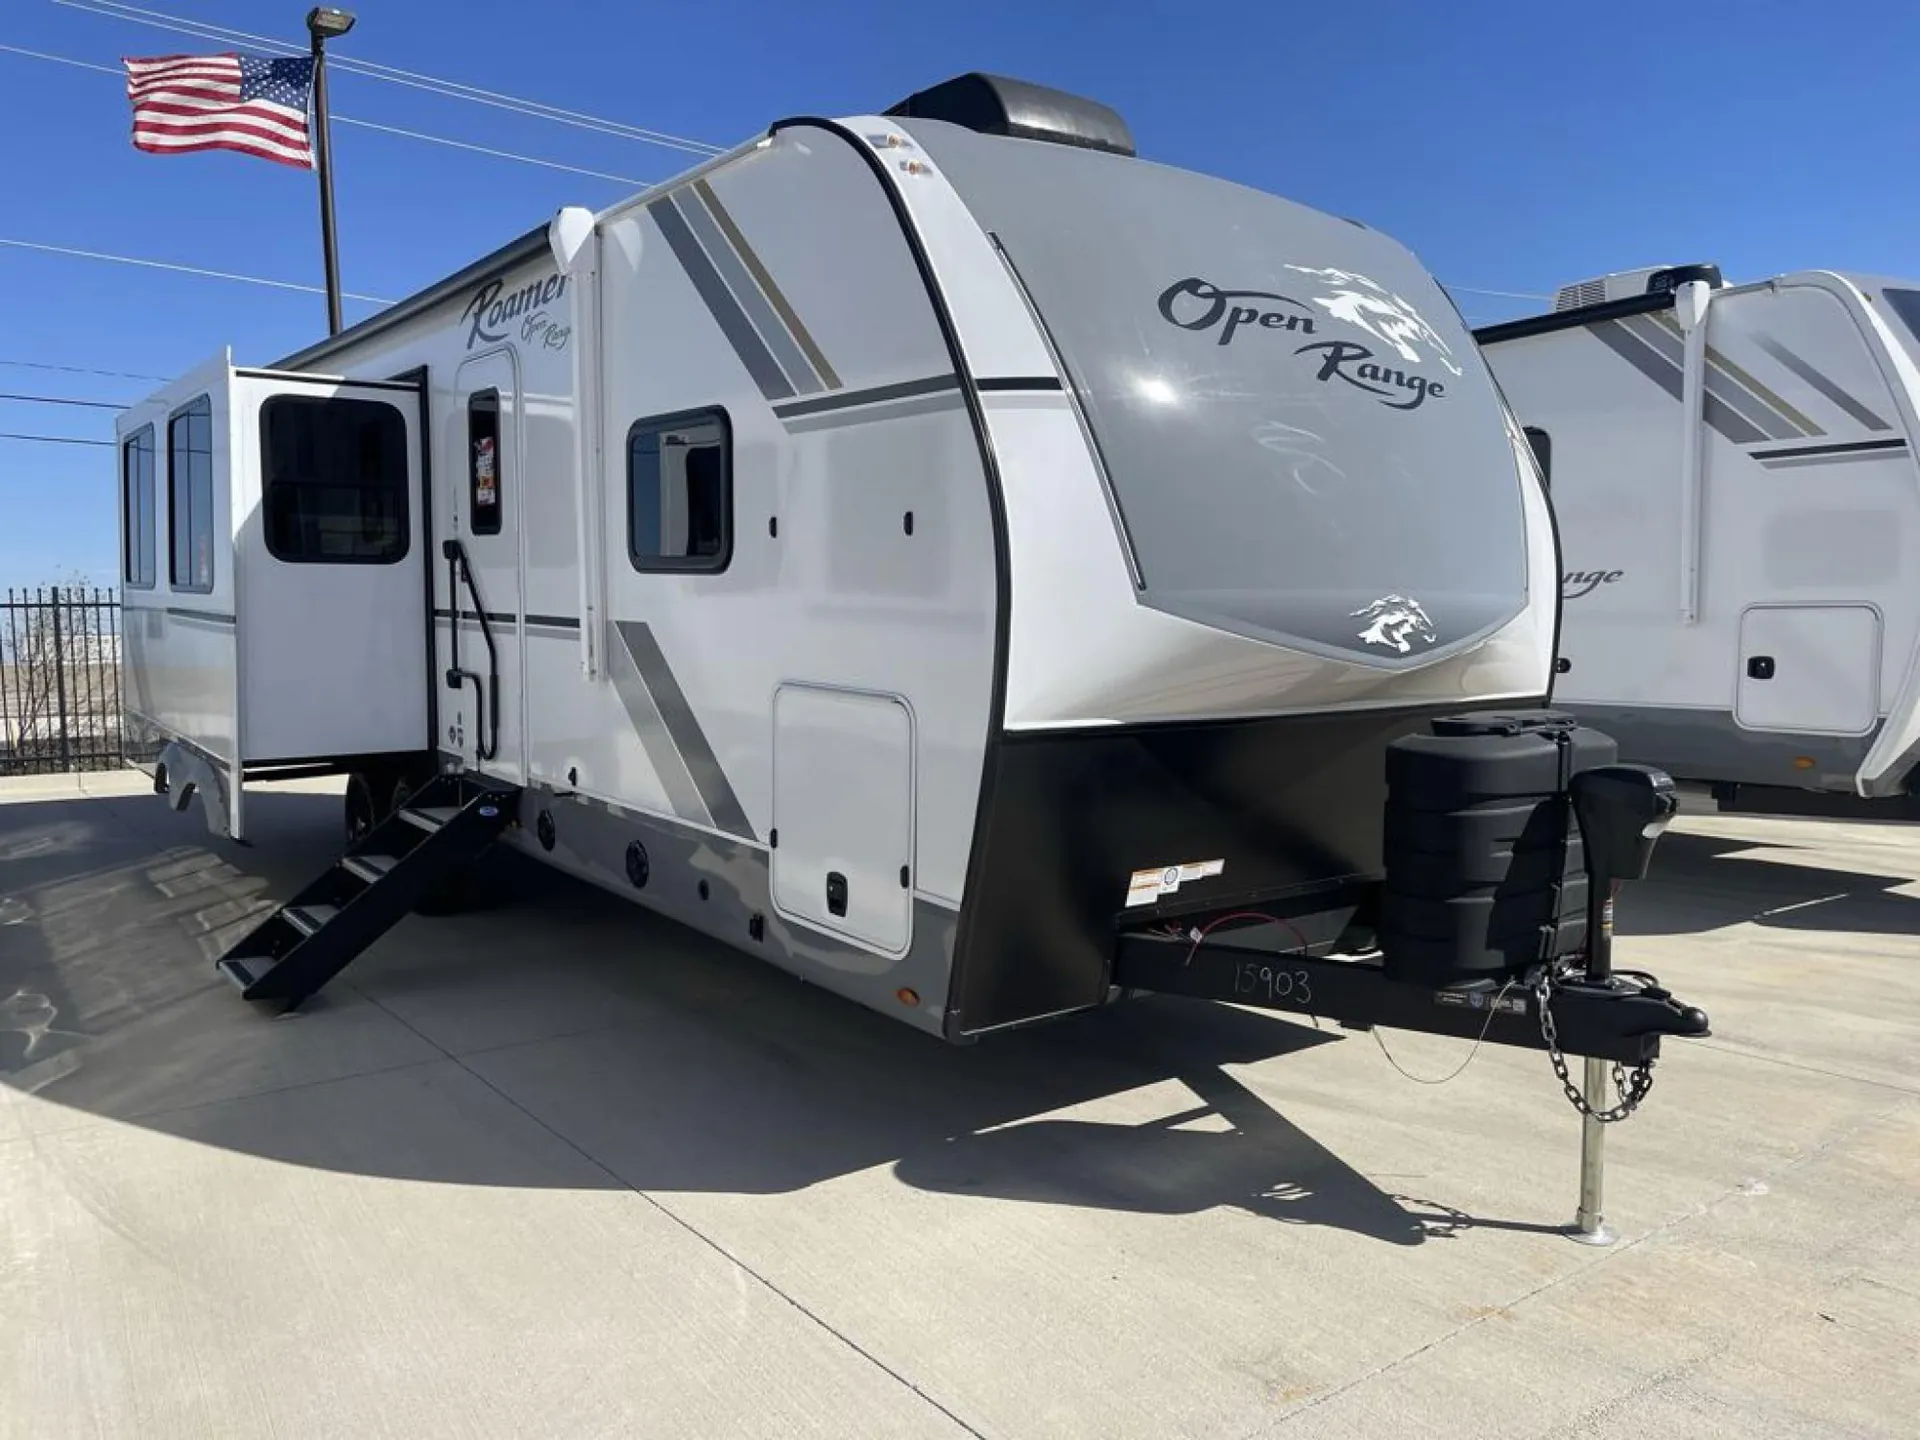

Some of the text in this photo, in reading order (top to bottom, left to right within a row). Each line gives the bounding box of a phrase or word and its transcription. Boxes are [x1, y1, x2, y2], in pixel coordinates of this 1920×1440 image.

[521, 311, 571, 349] Open Rang
[1158, 277, 1316, 345] Open
[1294, 341, 1447, 410] Range
[1562, 570, 1623, 598] nge
[1233, 961, 1312, 1004] 15903
